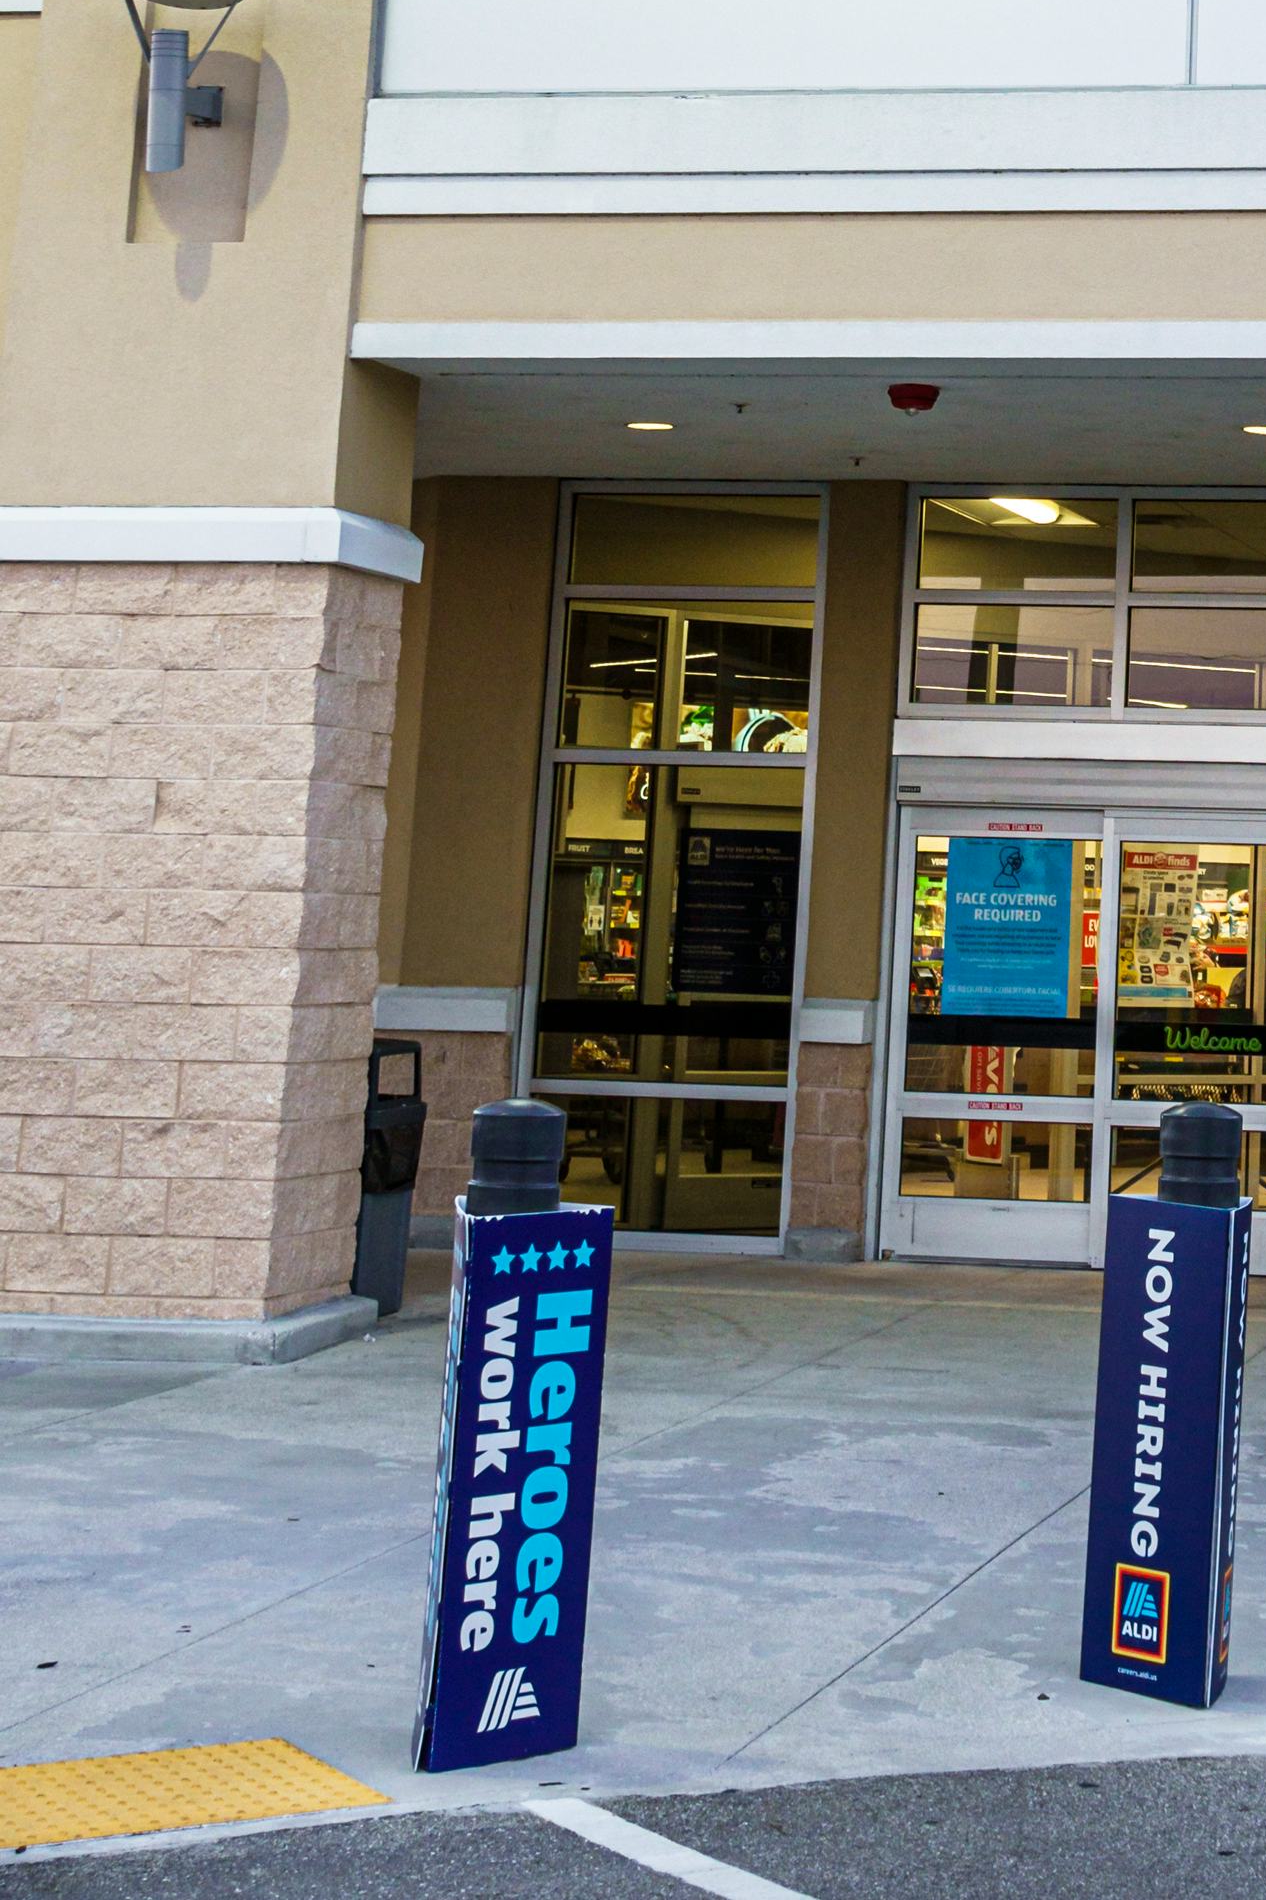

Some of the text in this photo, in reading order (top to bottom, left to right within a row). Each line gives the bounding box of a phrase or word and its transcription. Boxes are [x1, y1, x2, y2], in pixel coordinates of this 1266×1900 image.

[624, 846, 644, 855] BREA
[1132, 854, 1191, 866] ALDI finds
[955, 892, 1057, 907] FACE COVERING
[974, 908, 1041, 922] REQUIRED
[1163, 1025, 1263, 1052] Welcome
[1130, 1228, 1176, 1558] NOW HIRING
[460, 1296, 521, 1652] work here
[512, 1288, 593, 1645] Heroes
[1121, 1620, 1158, 1642] ALDI
[1117, 1666, 1158, 1682] careers.aldi.us
